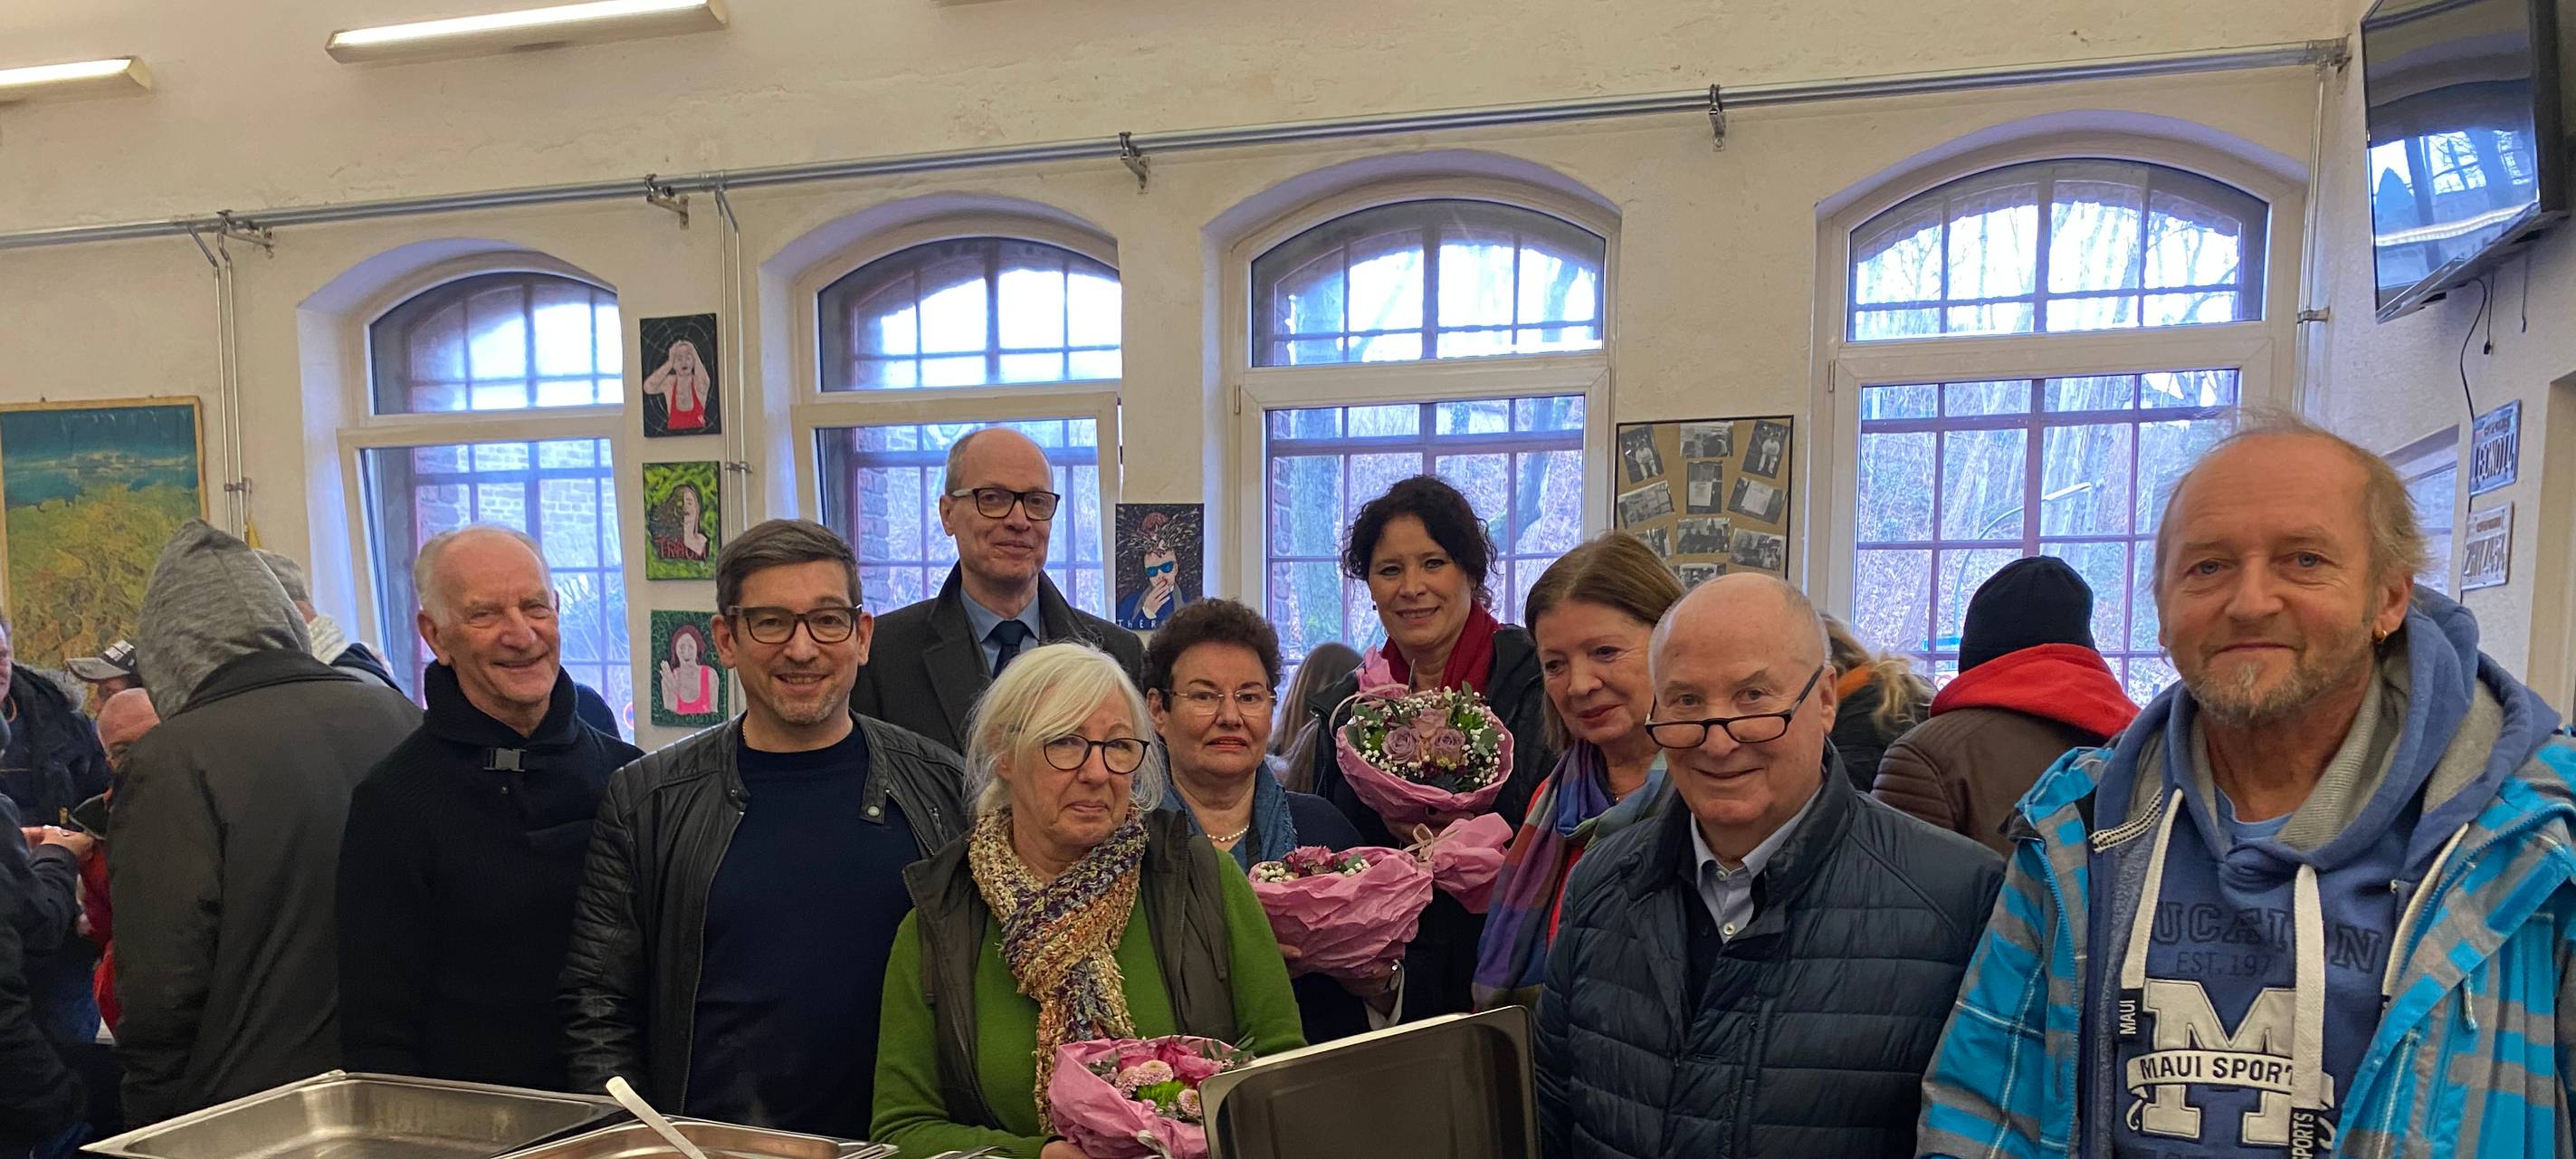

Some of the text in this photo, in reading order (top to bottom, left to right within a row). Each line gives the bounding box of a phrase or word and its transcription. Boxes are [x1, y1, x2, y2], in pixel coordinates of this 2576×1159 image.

[2119, 1000, 2136, 1035] MAUI
[2140, 1056, 2293, 1087] MAUI SPORT
[2292, 1112, 2314, 1159] PORTS
